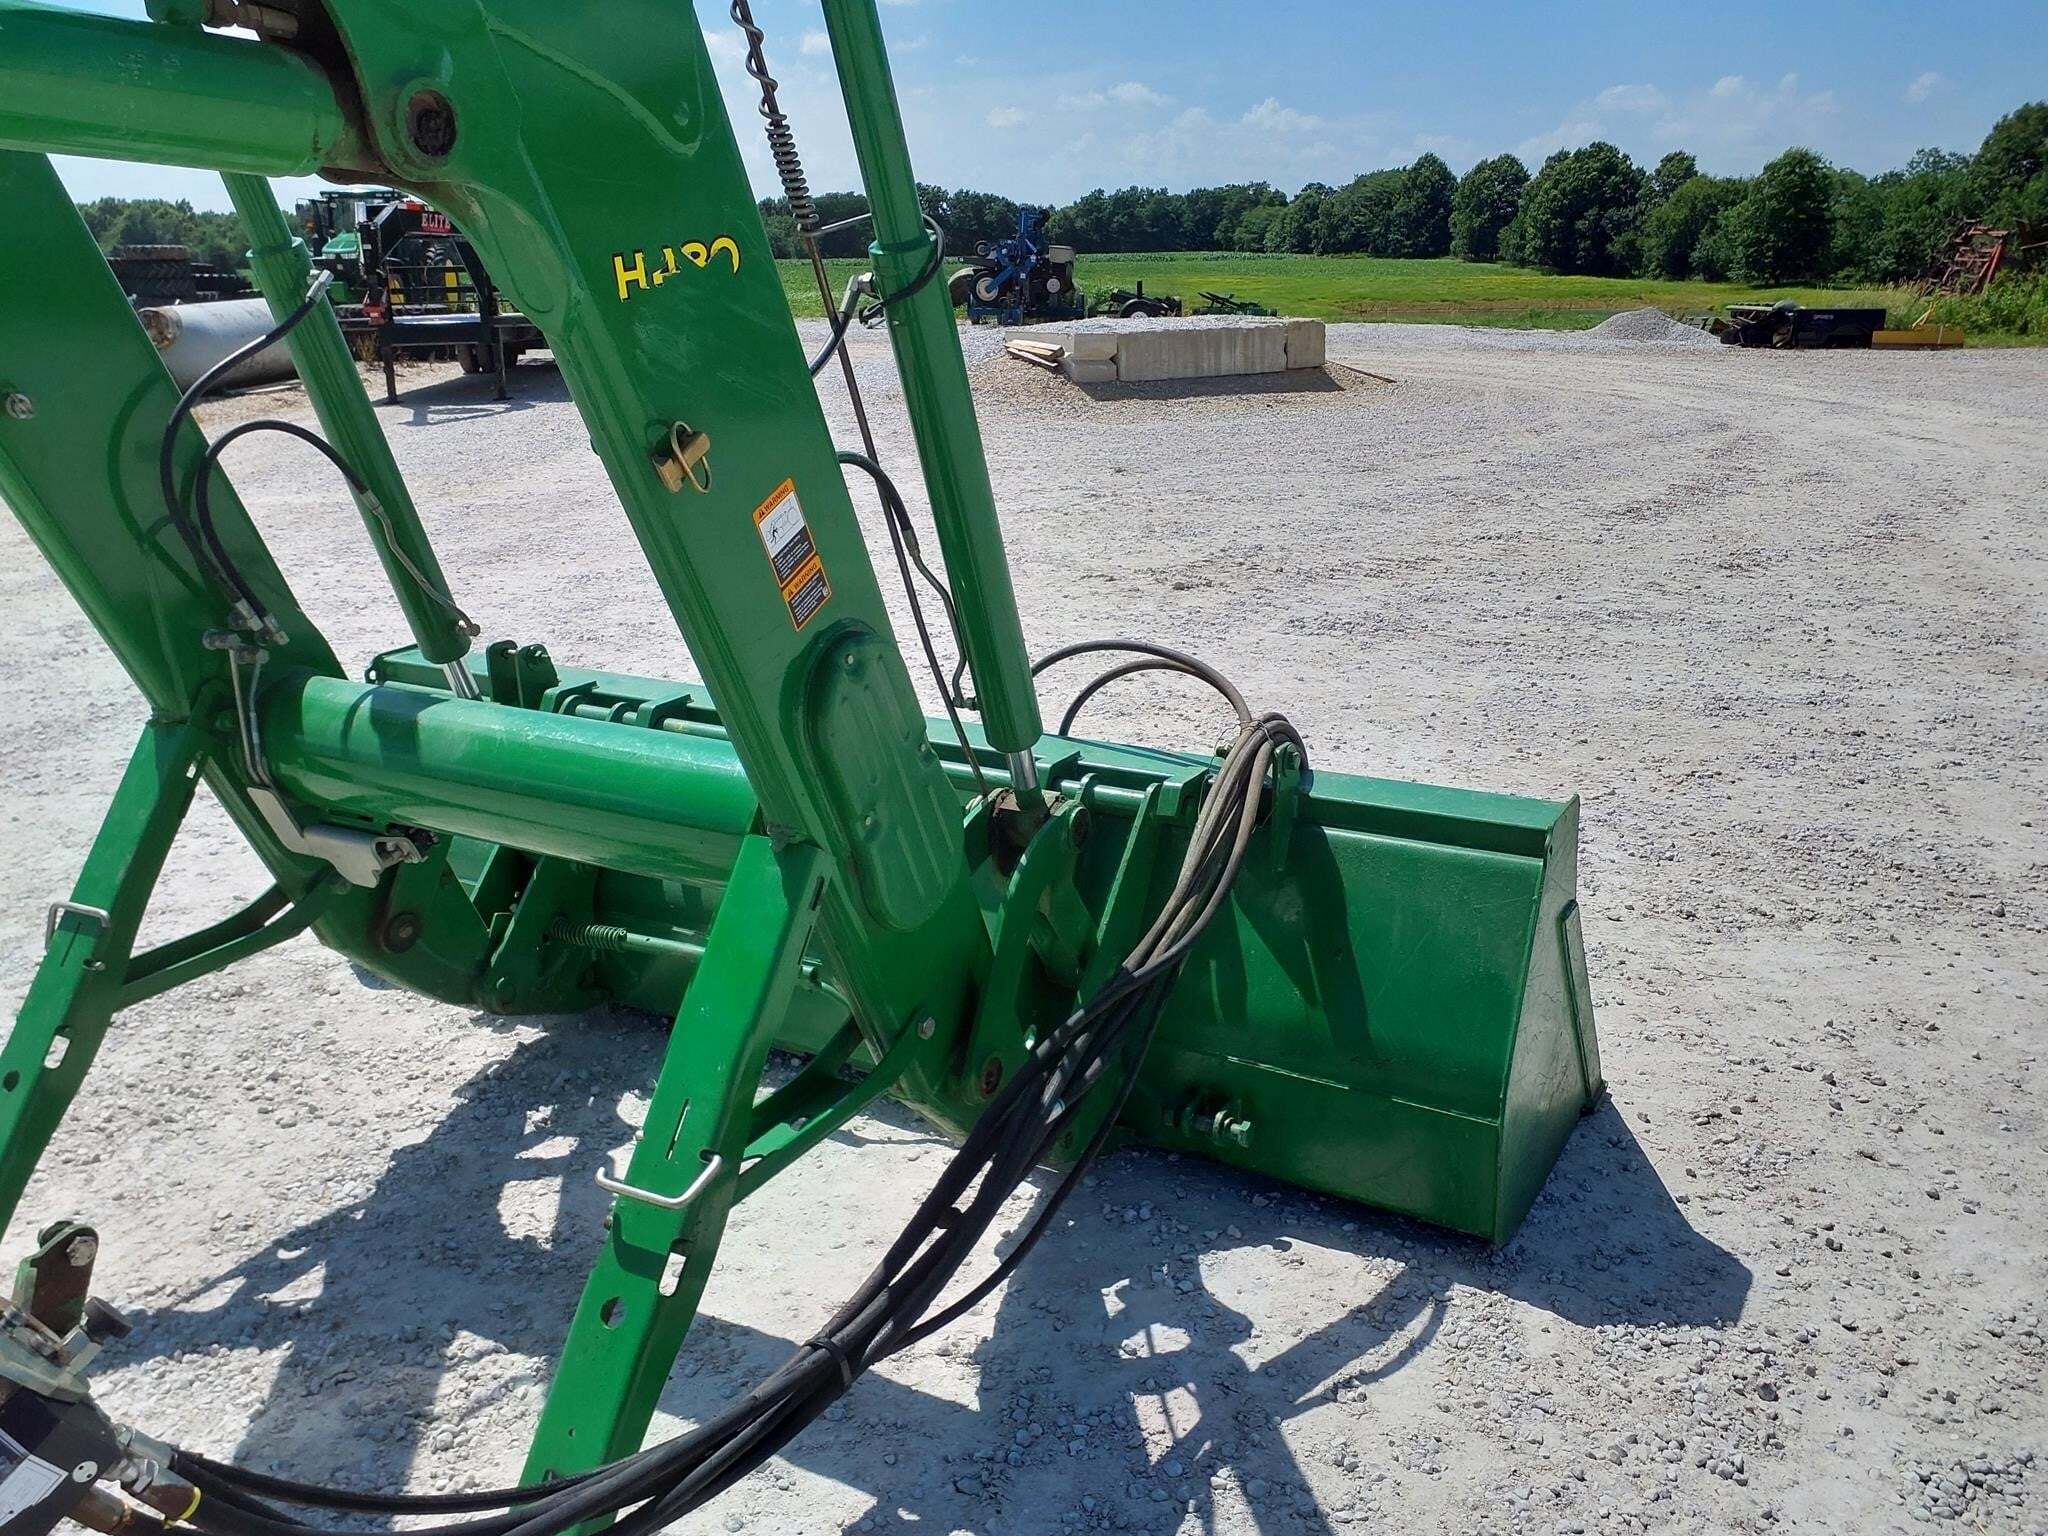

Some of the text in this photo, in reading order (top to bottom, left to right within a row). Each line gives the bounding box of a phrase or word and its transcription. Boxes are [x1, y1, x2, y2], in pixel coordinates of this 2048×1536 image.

[421, 213, 451, 229] ELITE
[763, 485, 790, 513] WARNING
[794, 563, 818, 590] WARNING
